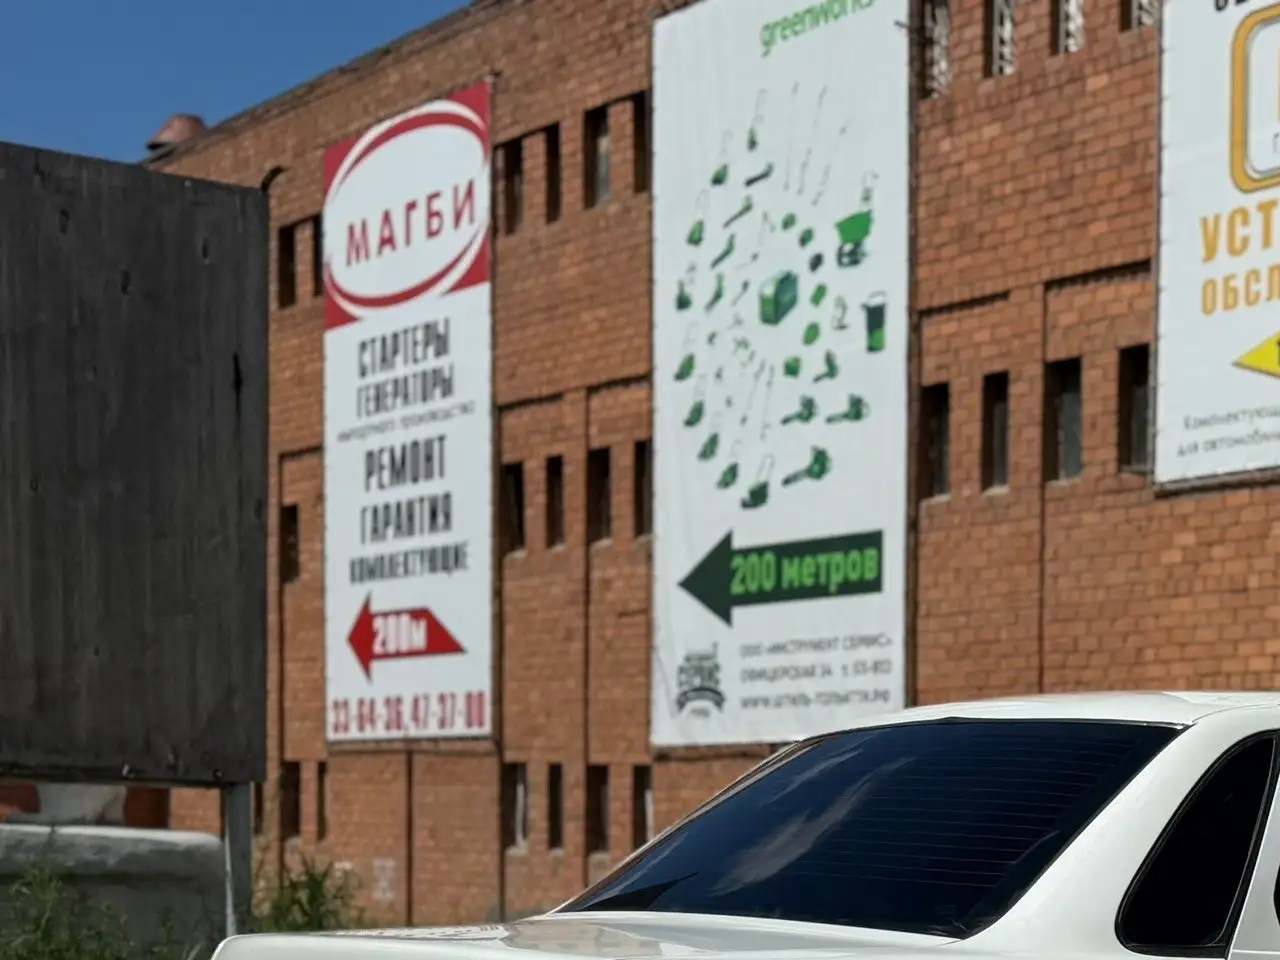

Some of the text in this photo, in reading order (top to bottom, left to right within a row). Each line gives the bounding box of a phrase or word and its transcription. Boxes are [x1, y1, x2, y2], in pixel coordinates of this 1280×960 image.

[346, 178, 475, 267] МАГБИ
[358, 317, 450, 379] СТАРТЕРЫ
[356, 363, 455, 419] ГЕНЕРАТОРЫ
[365, 434, 447, 492] РЕМОНТ
[361, 493, 453, 544] ГАРАНТИЯ
[730, 547, 879, 595] 200 метров
